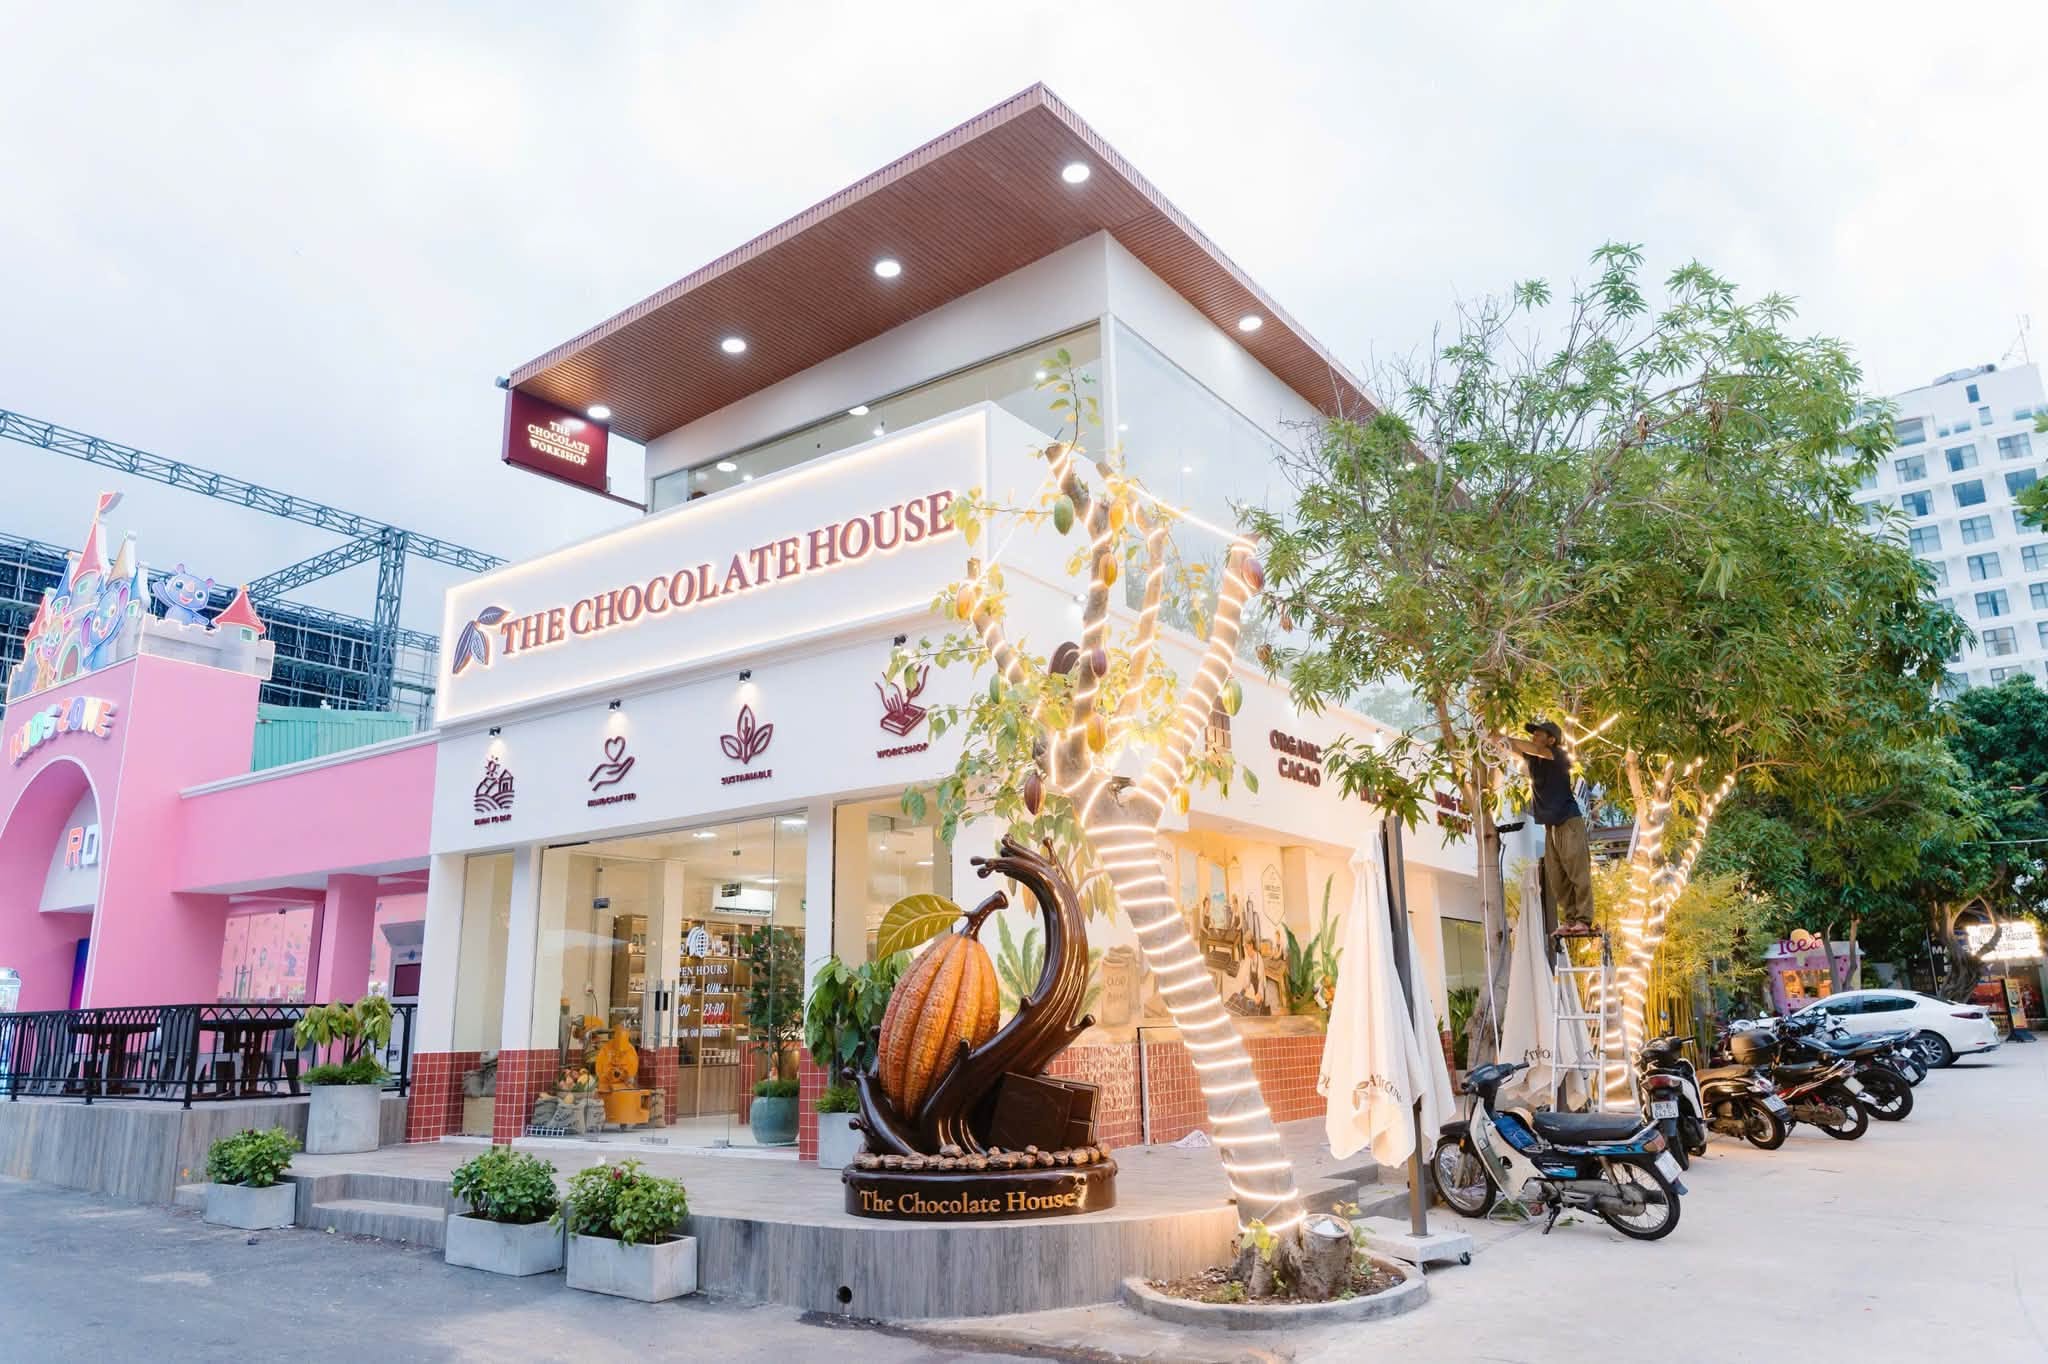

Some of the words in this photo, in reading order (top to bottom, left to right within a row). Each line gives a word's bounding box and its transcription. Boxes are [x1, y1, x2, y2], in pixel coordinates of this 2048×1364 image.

[527, 424, 590, 454] CHOCOLATE
[549, 421, 570, 437] THE
[529, 438, 588, 466] WORKSHOP
[501, 607, 566, 655] THE
[570, 537, 801, 635] CHOCOLATE
[806, 490, 956, 571] HOUSE
[9, 703, 62, 765] KIDS
[57, 696, 115, 738] ZONE
[1269, 728, 1322, 765] ORGANIC
[1278, 756, 1321, 787] CACAO
[696, 964, 728, 976] HOURS
[703, 1002, 725, 1016] 23:00
[860, 1190, 895, 1213] The
[899, 1191, 1001, 1214] Chocolate
[1006, 1190, 1076, 1211] House
